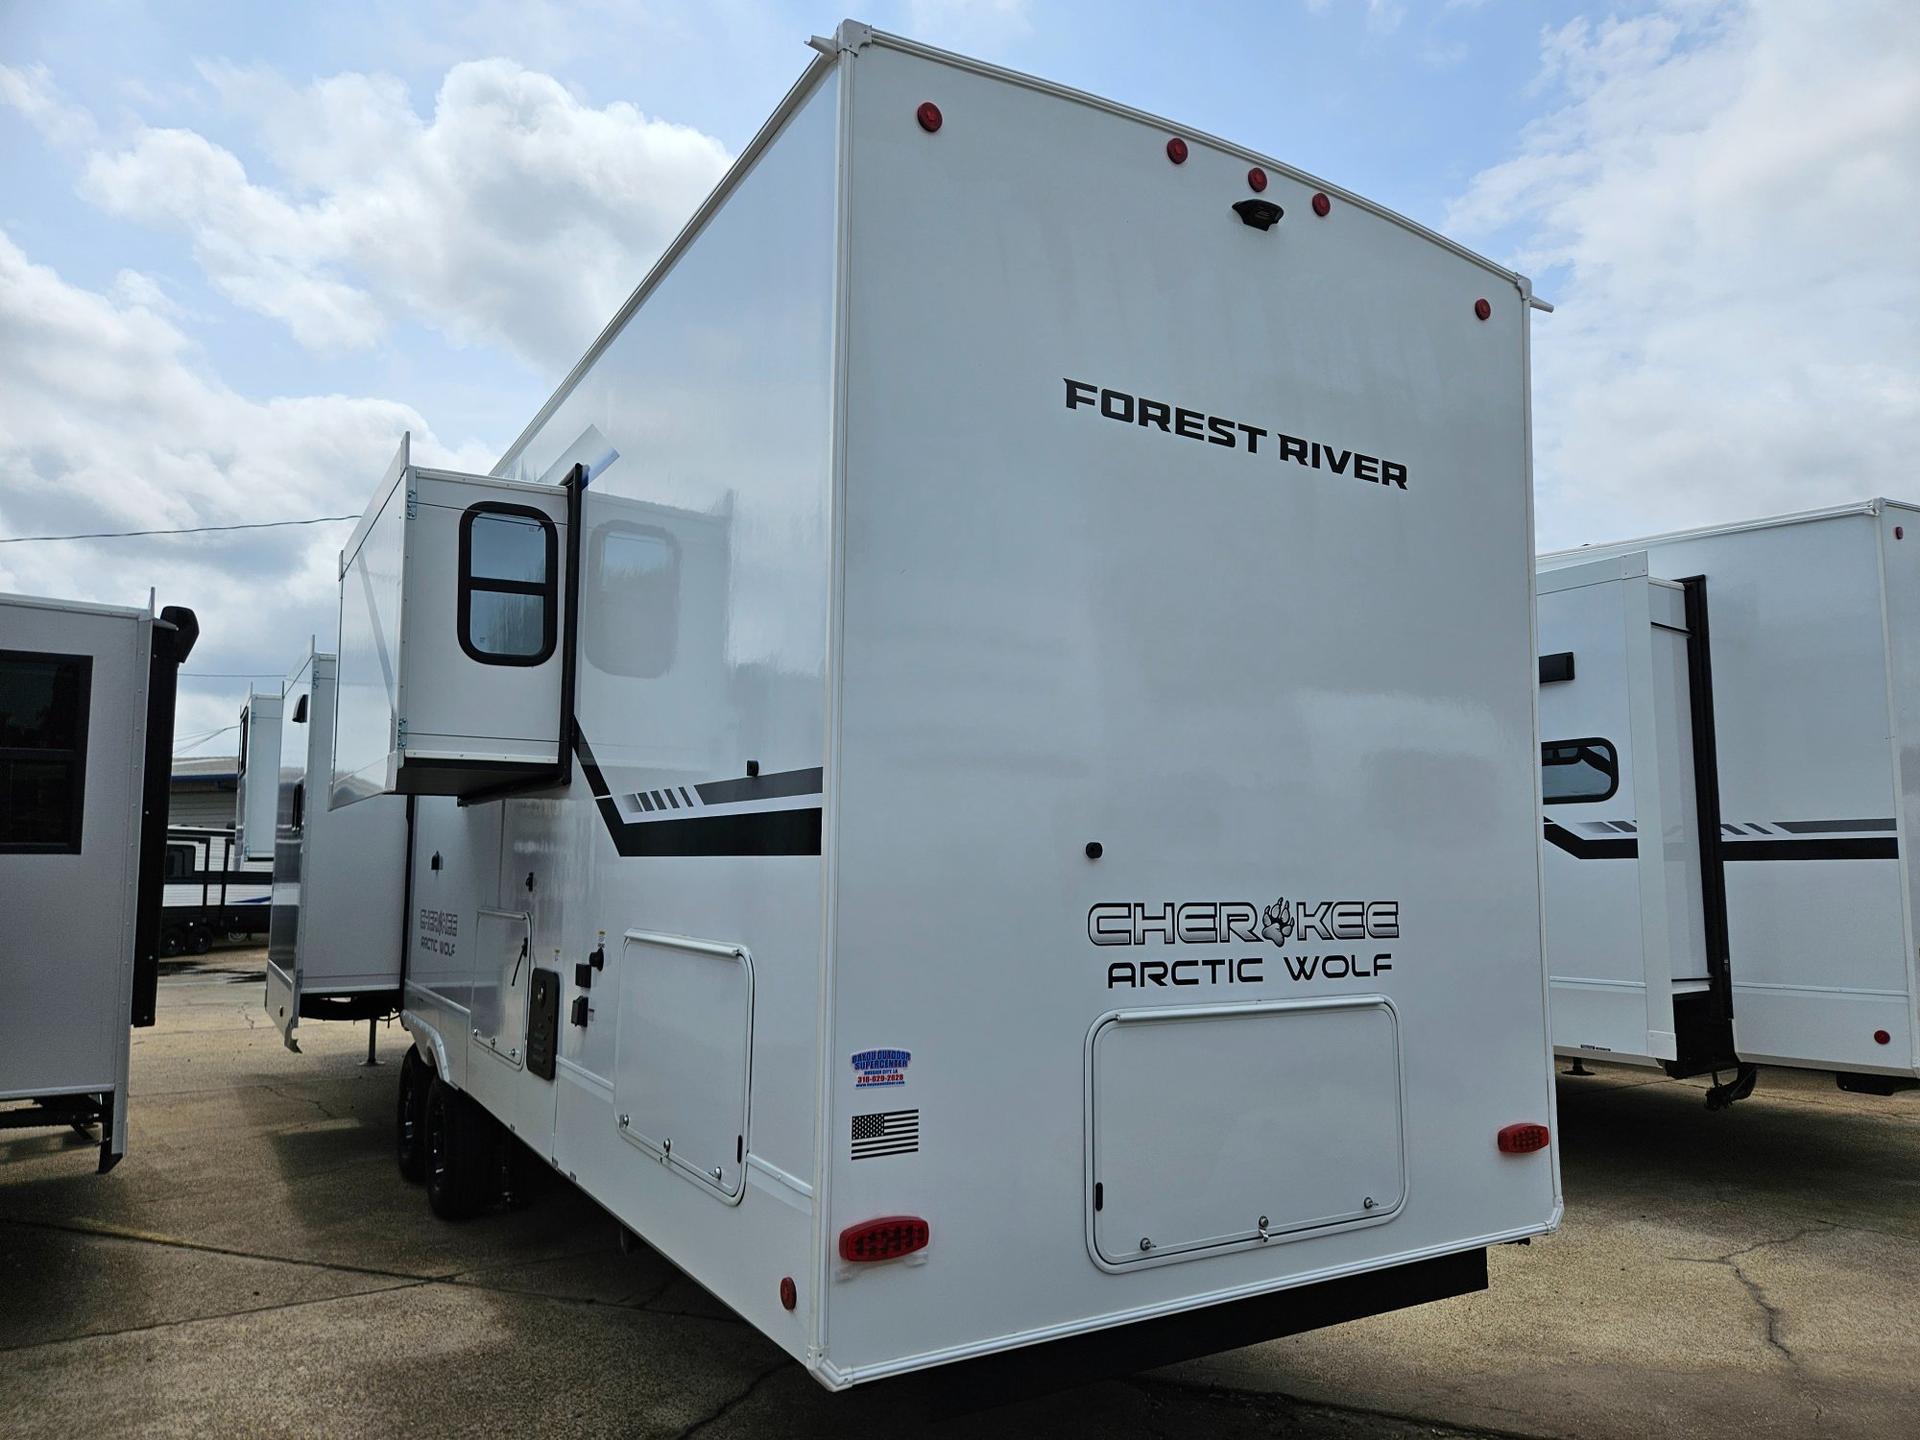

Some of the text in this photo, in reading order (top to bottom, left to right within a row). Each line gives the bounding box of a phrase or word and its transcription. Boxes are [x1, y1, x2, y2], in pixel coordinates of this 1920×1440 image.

[1063, 377, 1408, 491] FOREST RIVER
[1107, 953, 1393, 989] ARCTIC WOLF
[854, 1059, 908, 1070] SUPERCENTER
